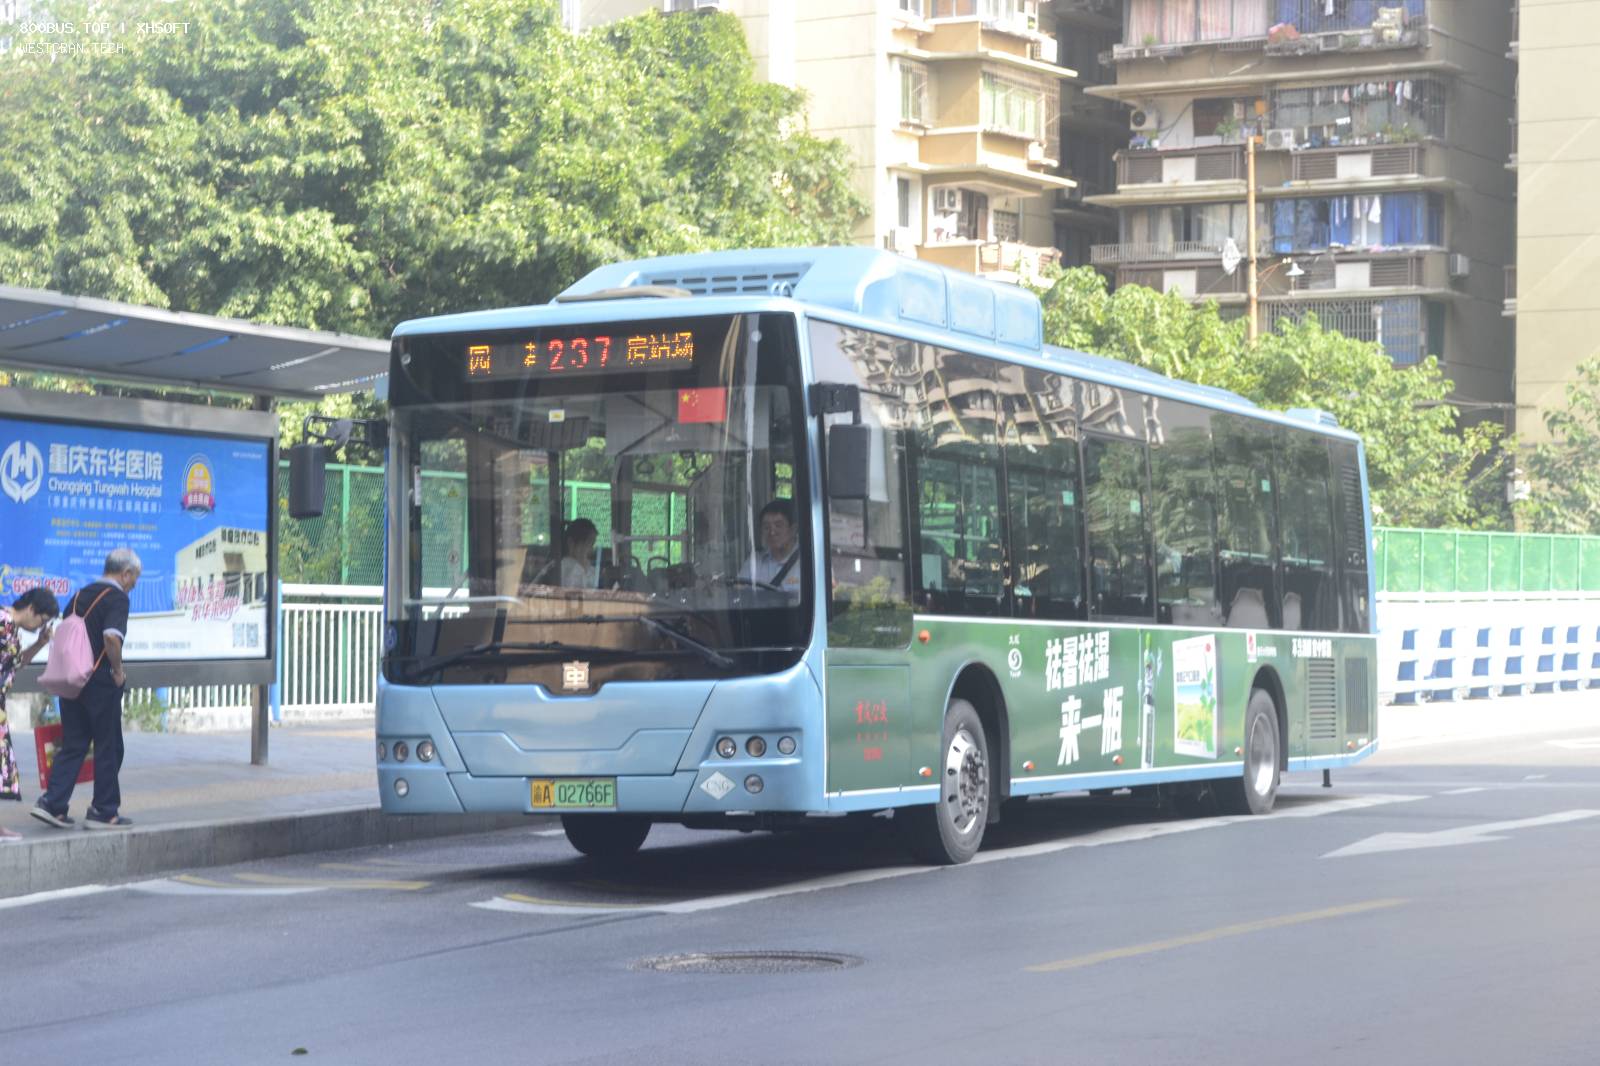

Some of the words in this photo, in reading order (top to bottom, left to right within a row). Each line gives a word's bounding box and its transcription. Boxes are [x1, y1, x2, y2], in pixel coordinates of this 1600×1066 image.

[548, 336, 611, 370] 237
[48, 443, 163, 481] 重庆东华医院
[48, 477, 92, 496] Chongqing
[131, 482, 163, 499] Hospital
[1045, 630, 1110, 692] 祛暑祛湿
[1057, 685, 1124, 766] 来一瓶
[558, 783, 612, 804] 02766F
